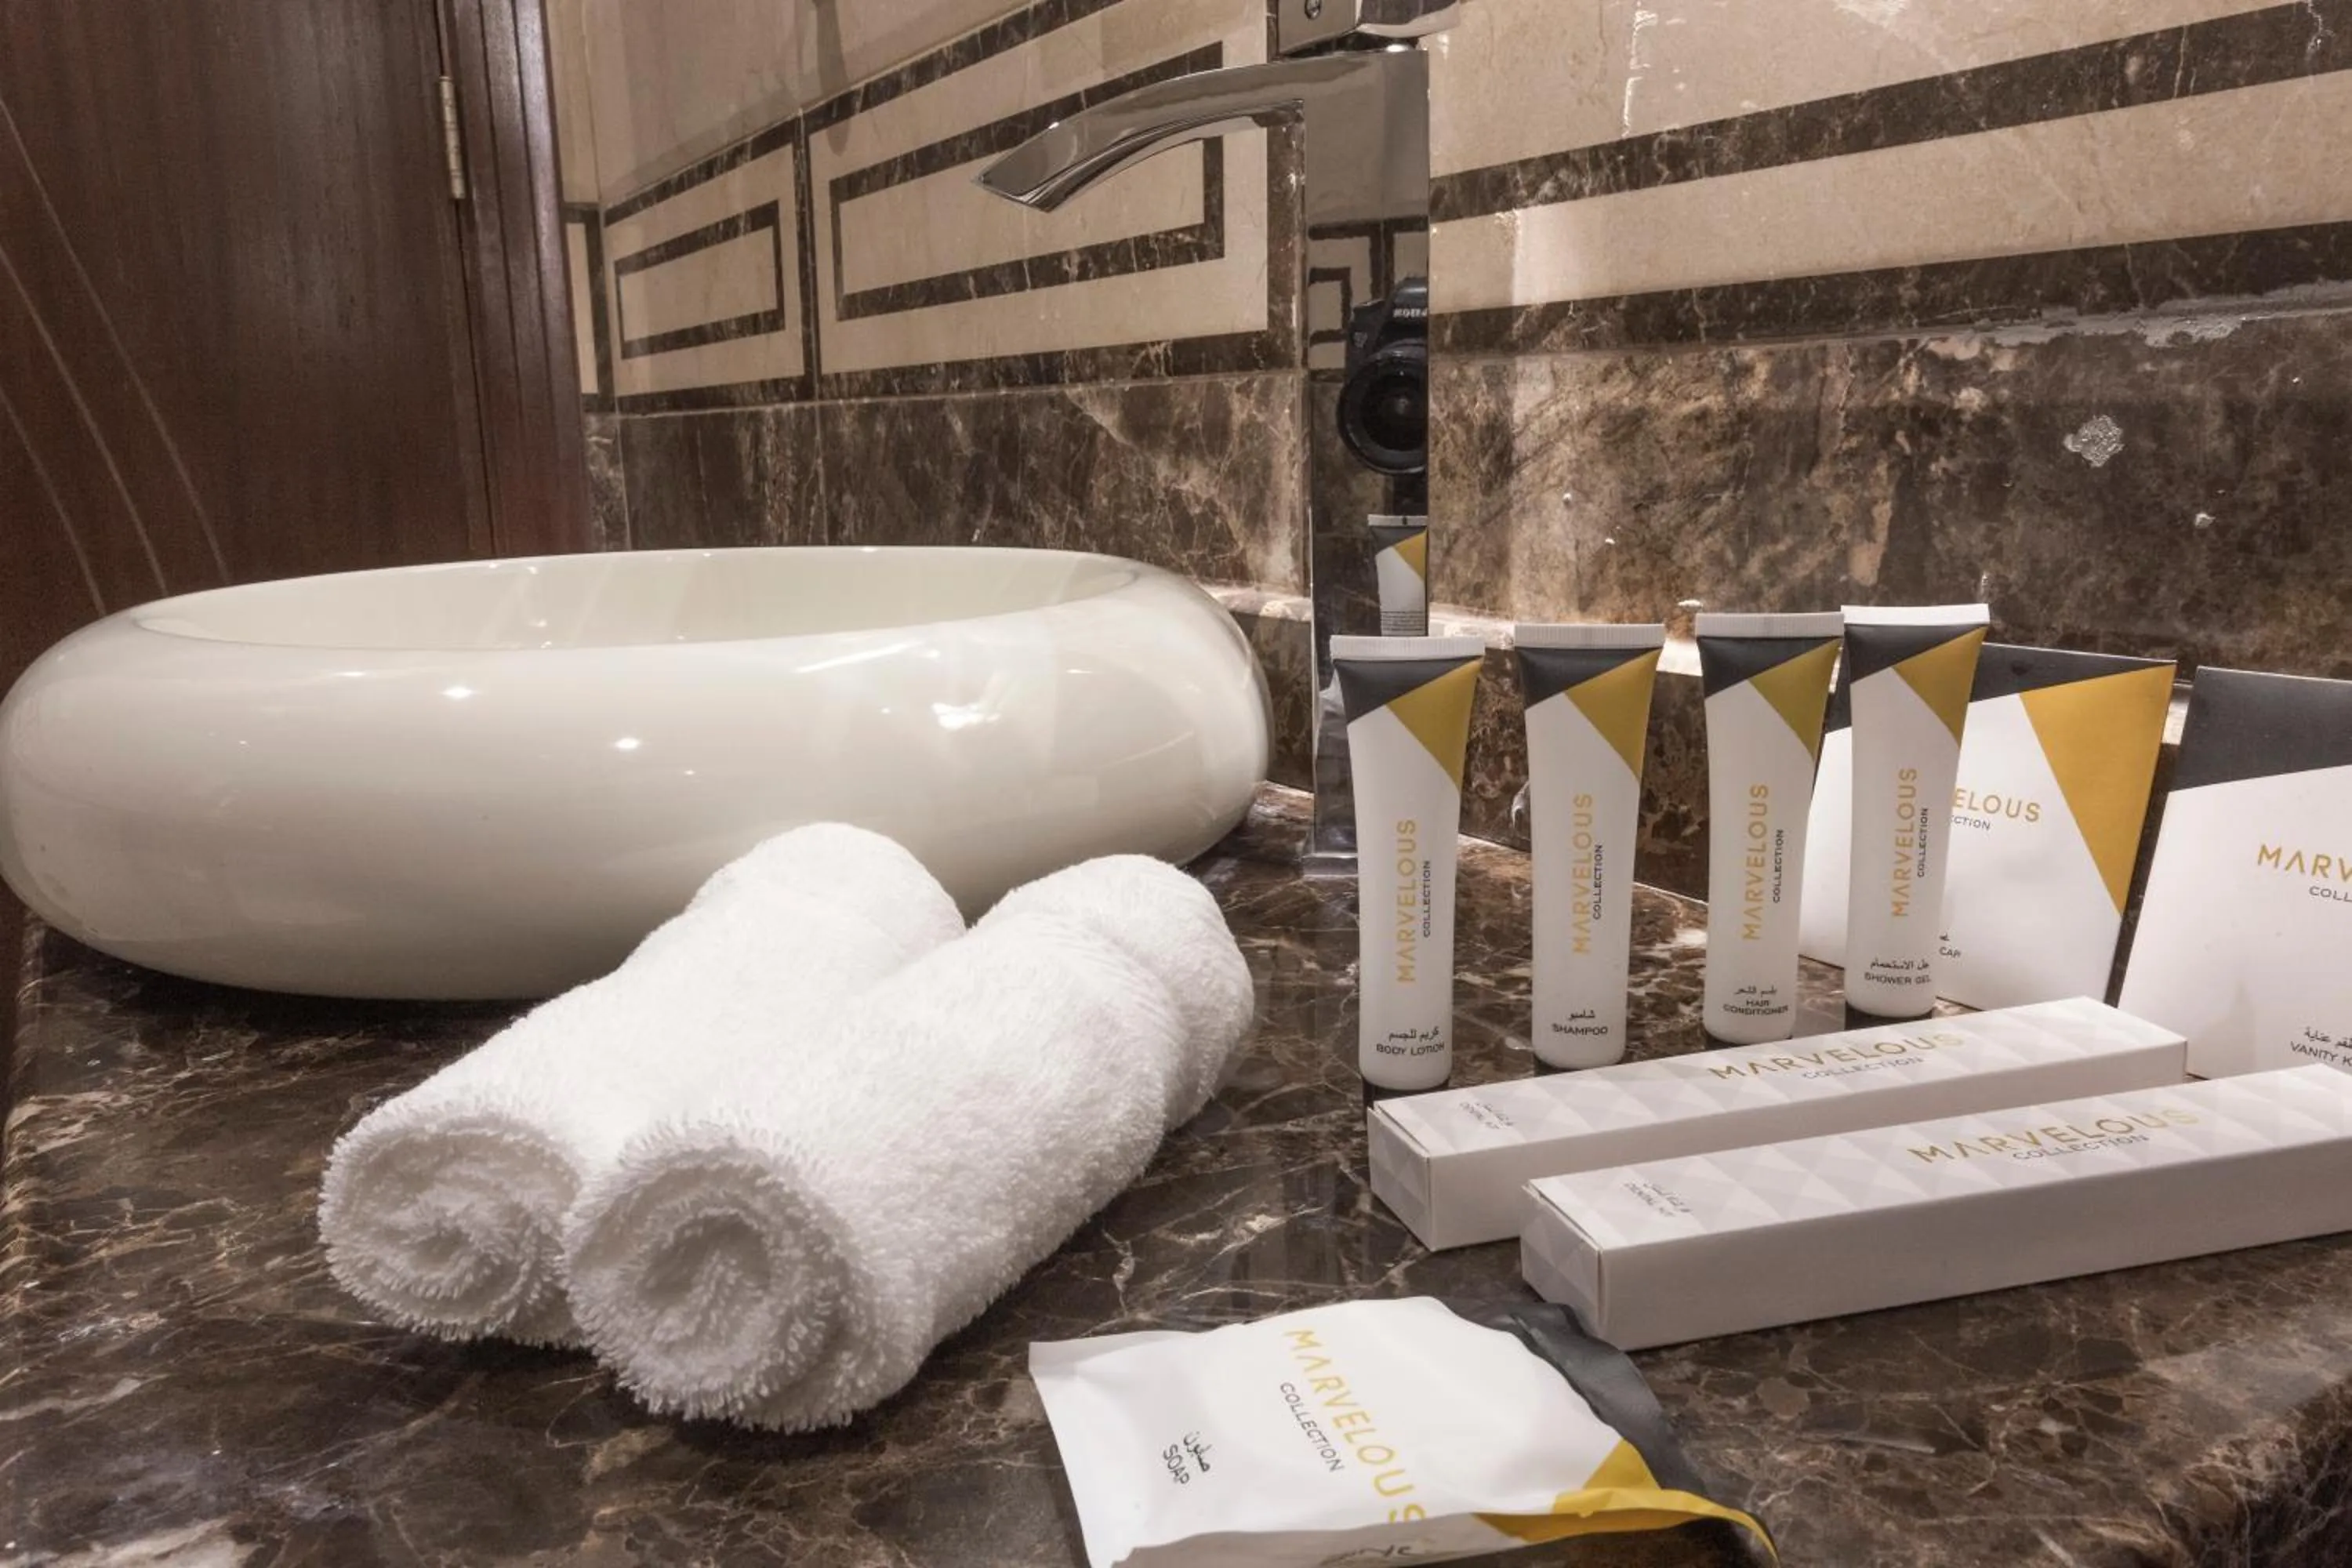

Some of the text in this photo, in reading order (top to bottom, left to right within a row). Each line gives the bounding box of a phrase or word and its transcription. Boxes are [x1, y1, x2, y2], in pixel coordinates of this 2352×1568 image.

[1951, 788, 2042, 822] ELOUS
[1951, 814, 1991, 831] CTION
[1741, 784, 1769, 940] MARVELOUS
[1773, 829, 1784, 903] COLLECTION
[1891, 768, 1918, 917] MARVELOUS
[1916, 807, 1929, 878] COLLECTION
[2257, 843, 2352, 883] MARV
[1396, 820, 1417, 983] MARVELOUS
[1422, 861, 1431, 938] COLLECTION
[1572, 793, 1593, 955] MARVELOUS
[1592, 844, 1603, 920] COLLECTION
[2308, 885, 2352, 903] COLL
[1376, 1041, 1445, 1057] BODY LOTION
[1552, 1022, 1609, 1036] SHAMPOO
[1708, 1032, 1965, 1080] MARVELOUS
[2289, 1040, 2339, 1062] VANITY
[1907, 1108, 2199, 1164] MARVELOUS
[2012, 1134, 2150, 1160] COLLECTION
[1279, 1381, 1345, 1472] COLLECTION
[1283, 1328, 1426, 1524] MARVELOUS
[1162, 1444, 1190, 1485] SOAP
